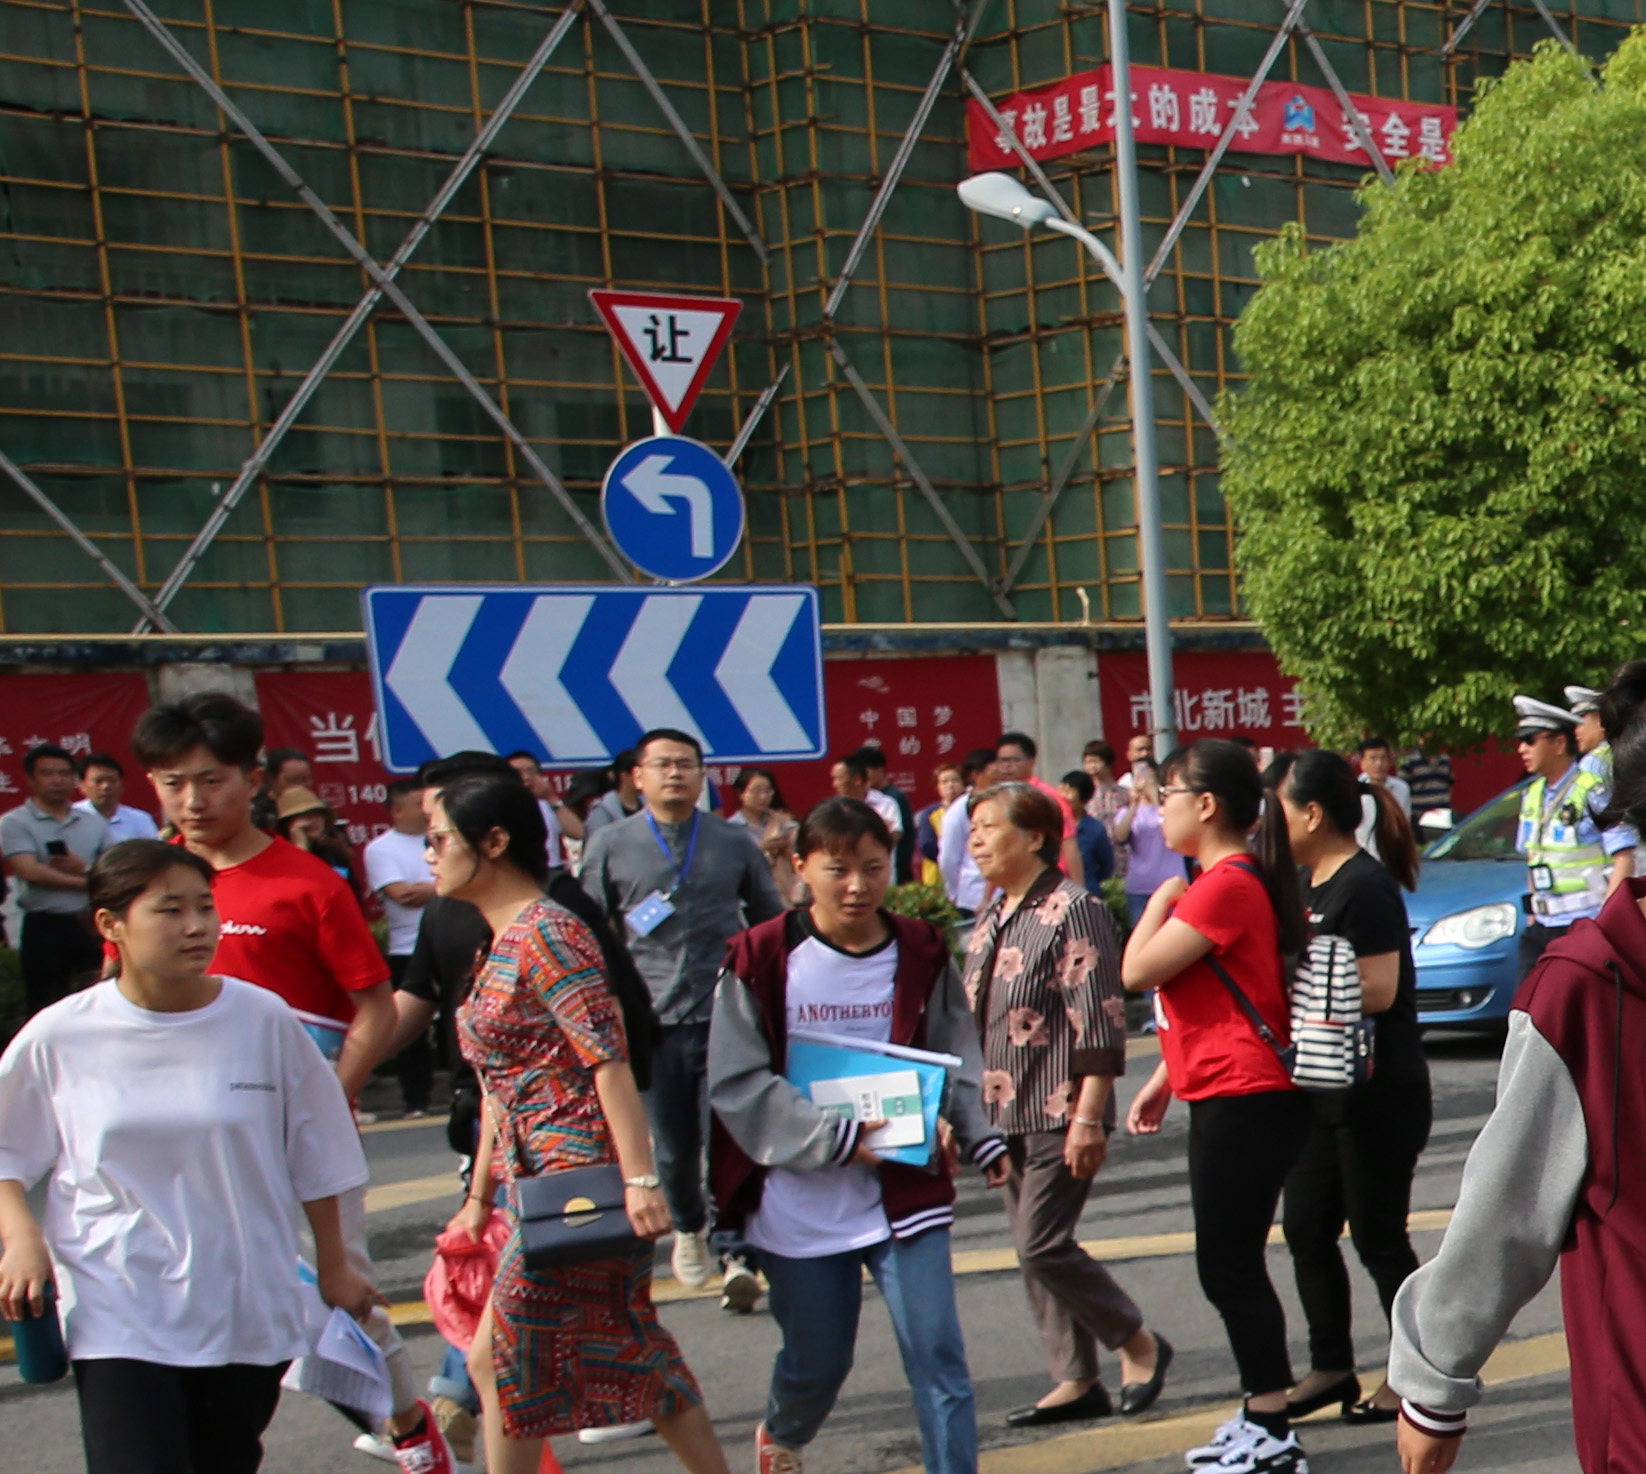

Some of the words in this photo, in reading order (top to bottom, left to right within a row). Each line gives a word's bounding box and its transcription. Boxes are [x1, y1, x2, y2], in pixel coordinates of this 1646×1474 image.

[643, 313, 693, 362] 让
[859, 705, 954, 730] 中国梦
[798, 1000, 894, 1024] ANOTHERYO
